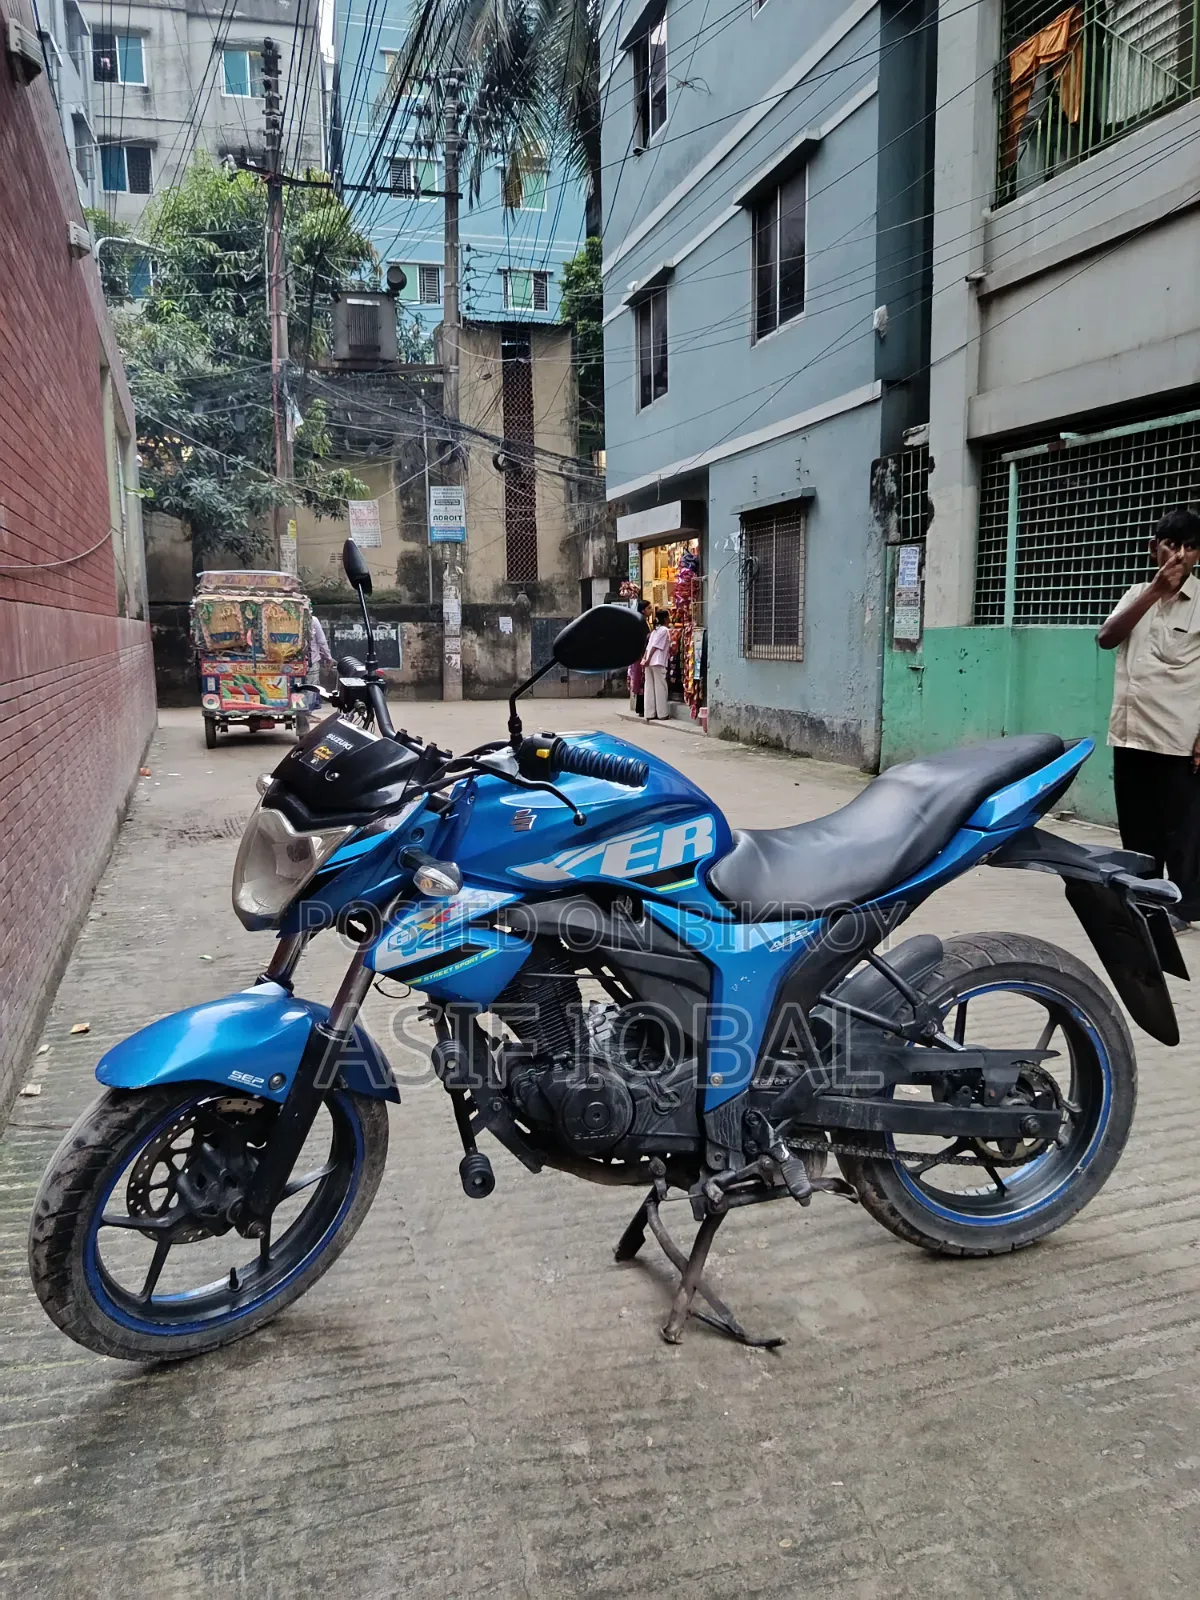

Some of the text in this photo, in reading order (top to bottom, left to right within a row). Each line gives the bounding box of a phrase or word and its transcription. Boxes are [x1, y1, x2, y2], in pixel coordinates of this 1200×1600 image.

[326, 733, 353, 750] SUZUKI
[423, 955, 479, 982] STREET SPORT
[229, 1070, 265, 1084] SEP
